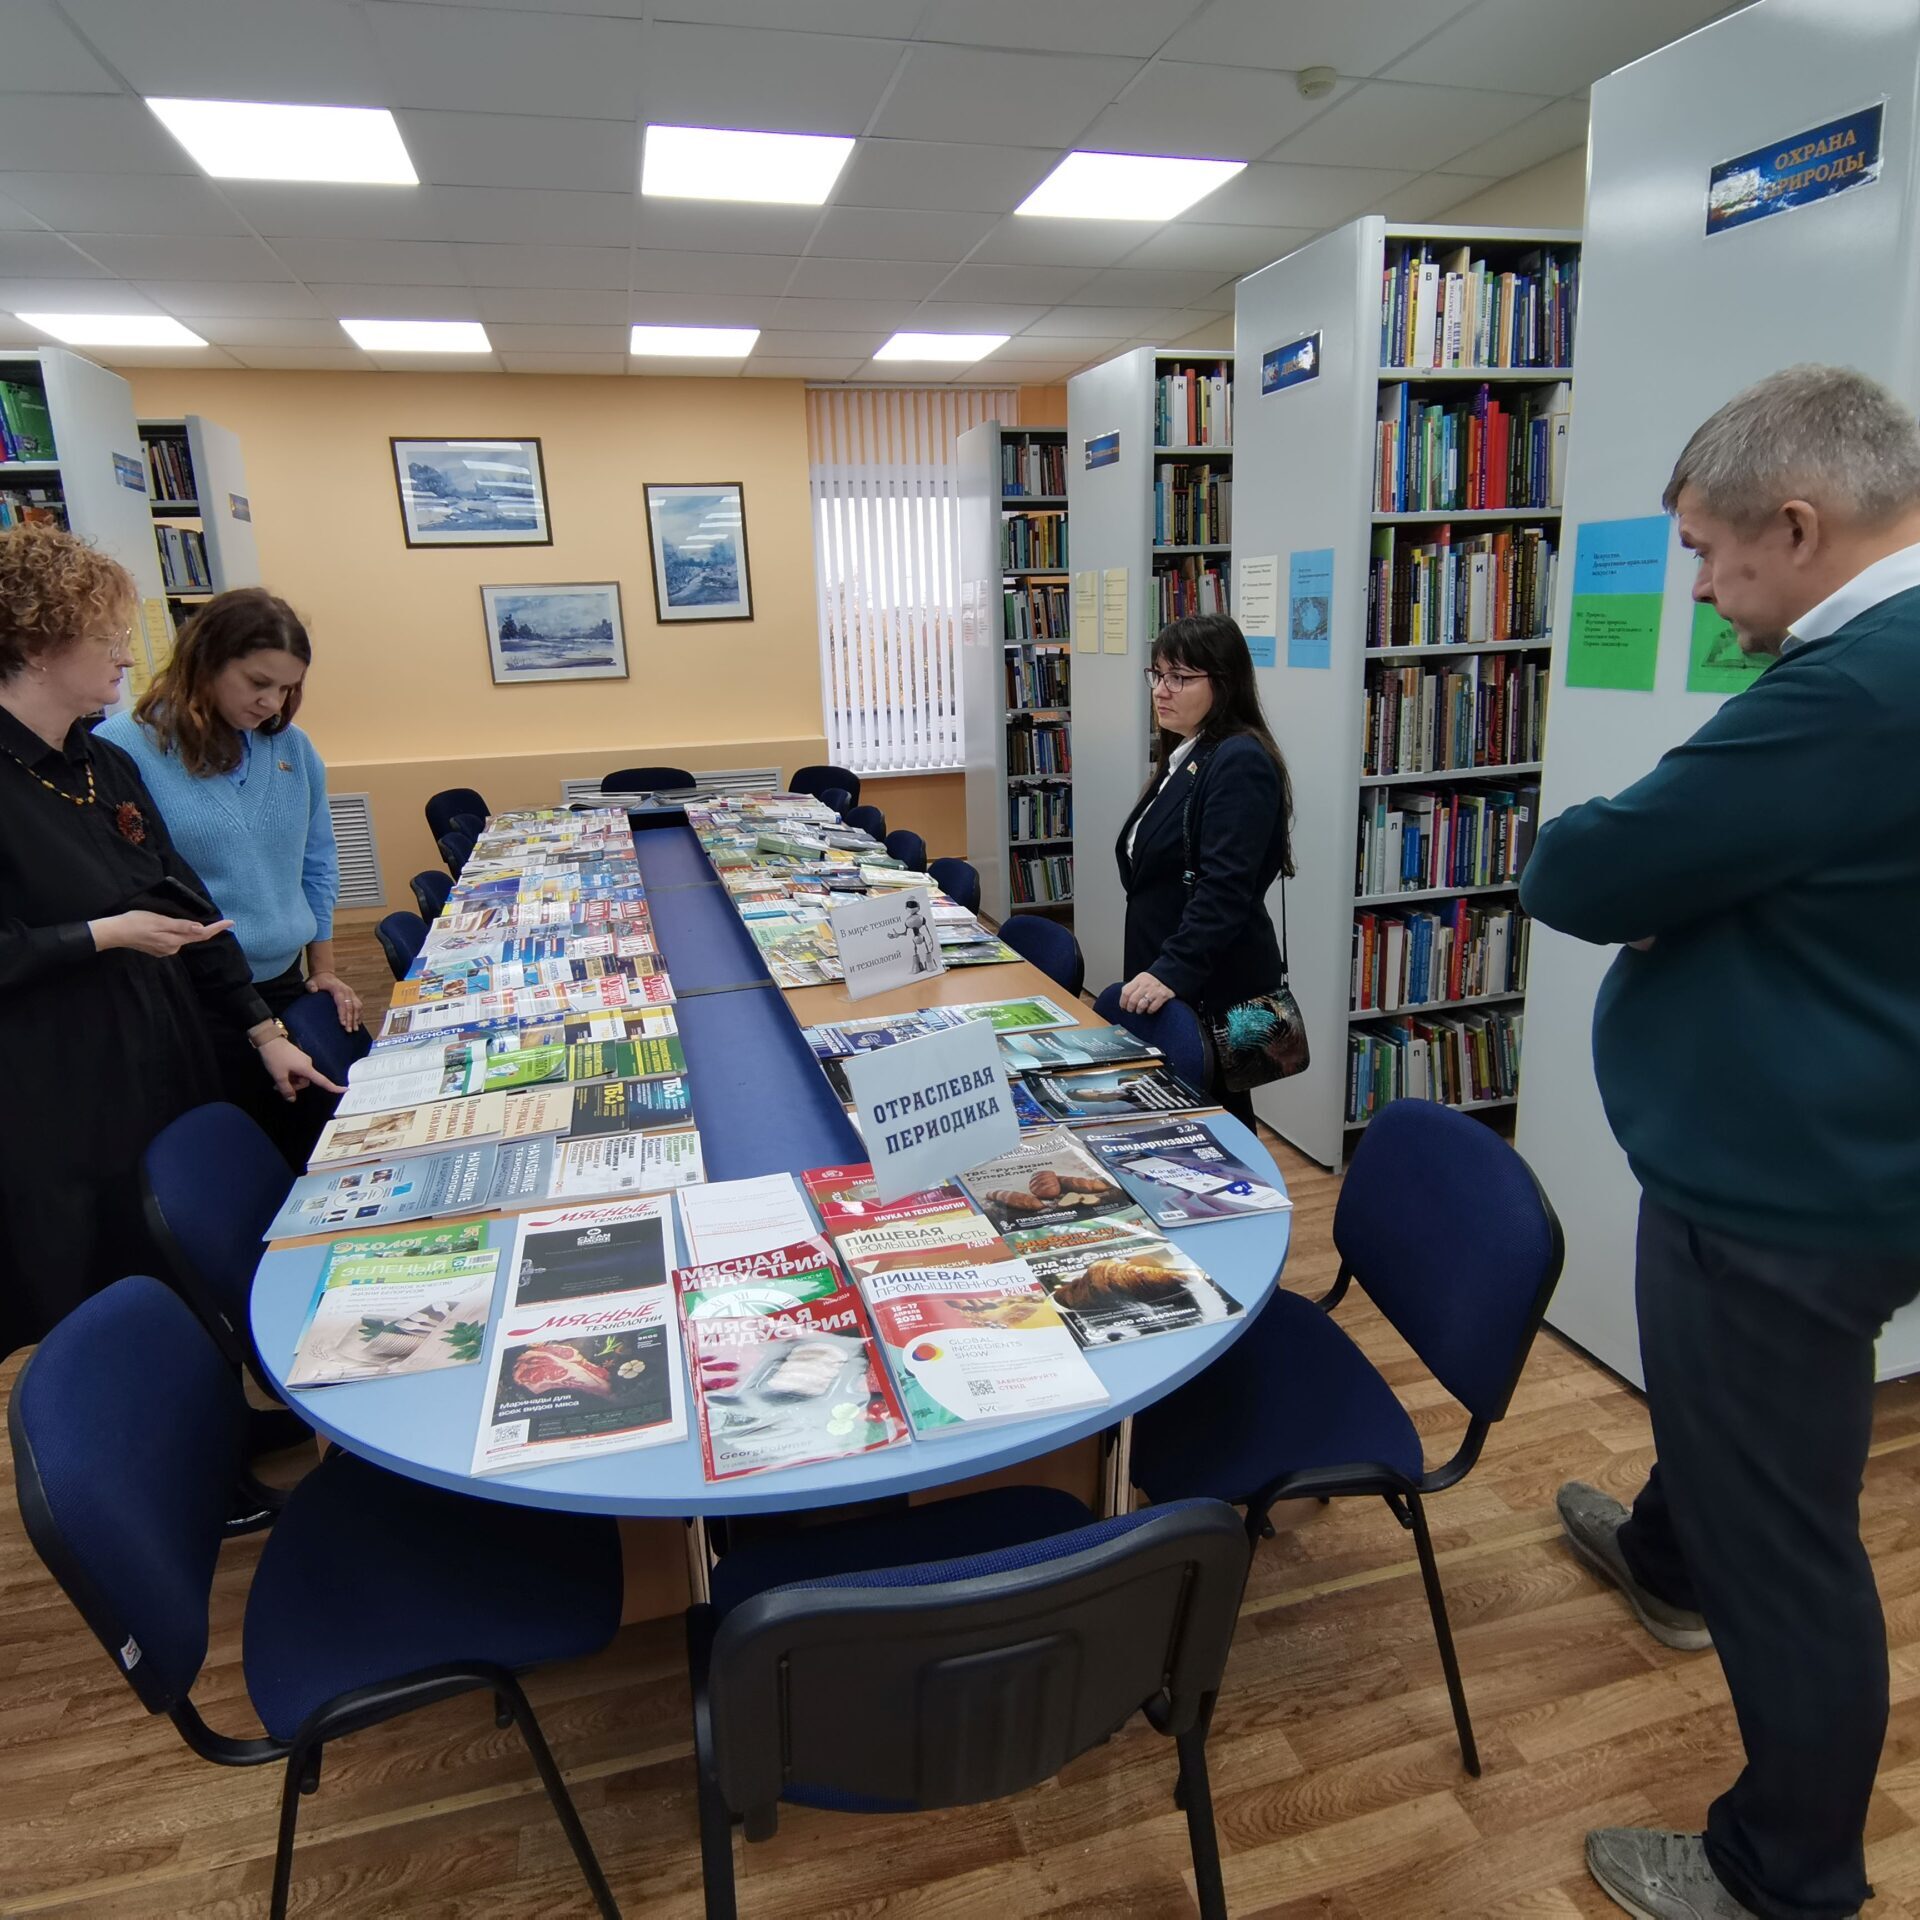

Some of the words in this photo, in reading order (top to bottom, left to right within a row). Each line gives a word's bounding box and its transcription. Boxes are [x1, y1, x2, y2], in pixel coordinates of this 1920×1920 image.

[1775, 129, 1857, 170] ОХРАНА
[840, 929, 847, 938] В
[848, 925, 869, 936] мире
[871, 916, 902, 930] техники
[857, 950, 902, 970] технологий
[376, 1027, 465, 1047] БЕЗОПАСНОСТЬ
[873, 1066, 995, 1124] ОТРАСЛЕВАЯ
[885, 1096, 1000, 1155] ПЕРИОДИКА
[1159, 1116, 1180, 1125] 2.24
[1177, 1124, 1198, 1135] 3.24
[1102, 1133, 1207, 1153] Стандартизация
[457, 1151, 480, 1202] НАУКОЁМКИЕ
[507, 1147, 524, 1195] ТЕХНОЛОГИИ
[520, 1144, 540, 1193] НАУКОЁМКИЕ
[964, 1169, 987, 1178] ТВС
[444, 1154, 464, 1204] ТЕХНОЛОГИИ
[556, 1201, 658, 1222] МЯСНЫЕ
[594, 1209, 659, 1224] ТЕХНОЛОГИИ
[874, 1213, 903, 1222] НАУКА
[912, 1201, 966, 1216] ТЕХНОЛОГИИ
[333, 1236, 428, 1254] Эколог
[844, 1226, 944, 1247] ПИЩЕВАЯ
[849, 1230, 988, 1256] ПРОМЫШЛЕННОСТЬ
[341, 1260, 448, 1277] ЗЕЛЕНЫЙ
[407, 1263, 489, 1277] КОНТЕЙНЕР
[679, 1250, 787, 1281] МЯСНАЯ
[682, 1251, 830, 1291] ИНДУСТРИЯ
[872, 1270, 979, 1288] ПИЩЕВАЯ
[876, 1275, 1027, 1299] ПРОМЫШЛЕННОСТЬ
[542, 1301, 662, 1328] МЯСНЫЕ
[585, 1314, 663, 1332] ТЕХНОЛОГИИ
[701, 1307, 813, 1335] МЯСНАЯ
[895, 1314, 923, 1324] 2025
[1113, 1318, 1135, 1327] ООО
[700, 1309, 858, 1348] ИНДУСТРИЯ
[949, 1336, 993, 1345] GLOBAL
[951, 1341, 1023, 1352] INGREDIENTS
[955, 1350, 991, 1359] SHOW
[498, 1407, 522, 1417] всех
[523, 1404, 554, 1414] видов
[555, 1400, 580, 1410] мяса
[500, 1396, 552, 1410] Маринады
[553, 1394, 572, 1402] для
